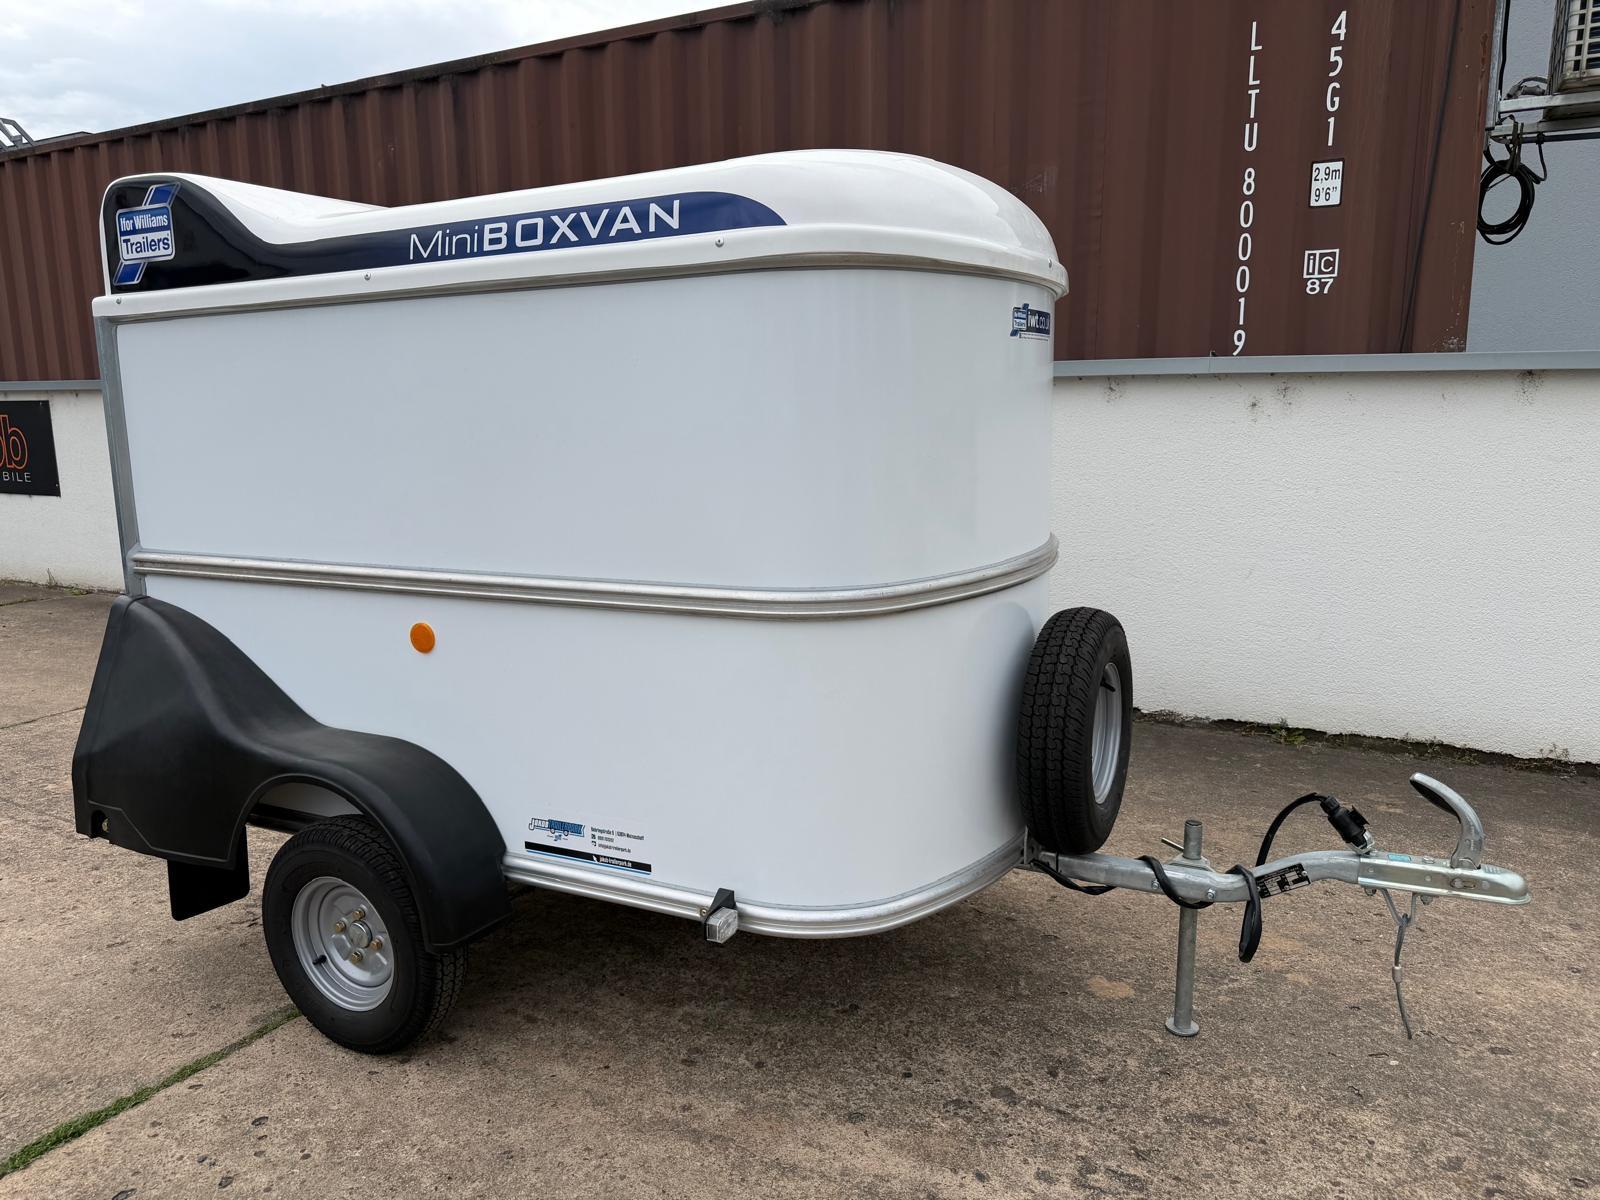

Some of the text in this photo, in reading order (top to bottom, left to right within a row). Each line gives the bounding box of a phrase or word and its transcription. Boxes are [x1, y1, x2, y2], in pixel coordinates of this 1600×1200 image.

[1326, 10, 1347, 147] 45G1
[1313, 166, 1341, 185] 2,9m
[1232, 21, 1263, 356] LLTU 800019
[120, 213, 169, 232] Ifor Williams
[409, 199, 680, 261] MiniBOXVAN
[122, 236, 171, 255] Trailers
[1305, 278, 1334, 295] 87
